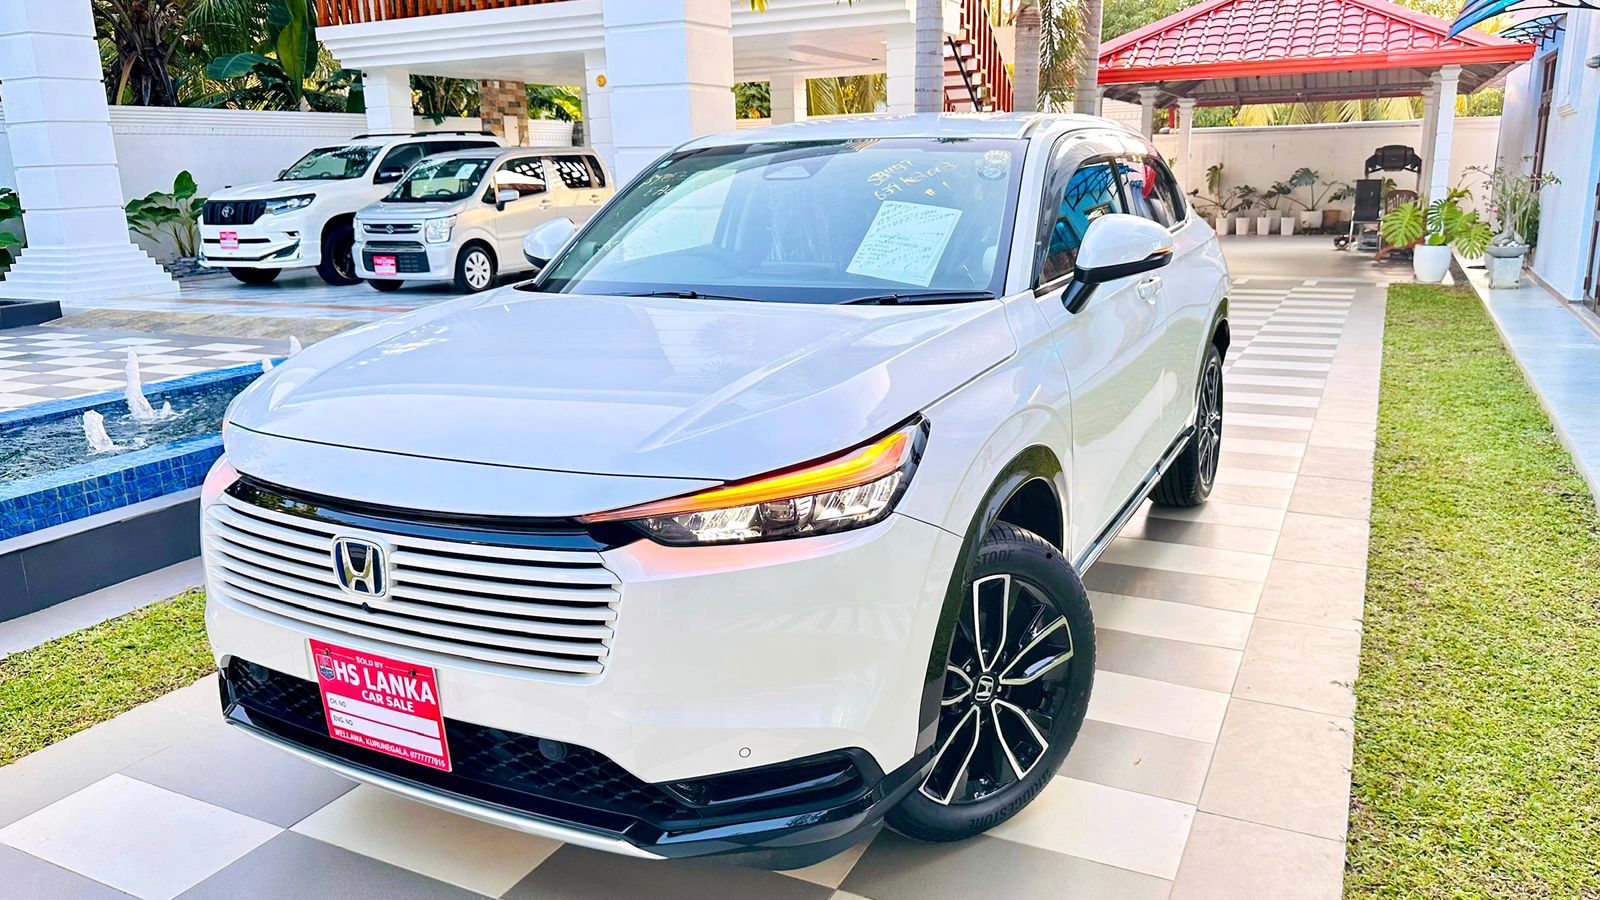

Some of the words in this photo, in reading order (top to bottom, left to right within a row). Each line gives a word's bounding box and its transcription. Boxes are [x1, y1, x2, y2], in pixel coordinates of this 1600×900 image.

[355, 656, 373, 667] SOLD
[374, 661, 384, 669] BY
[333, 659, 360, 687] HS
[363, 667, 437, 705] LANKA
[361, 690, 384, 705] CAR
[387, 697, 415, 713] SALE
[967, 768, 1054, 830] BRIDGESTONE
